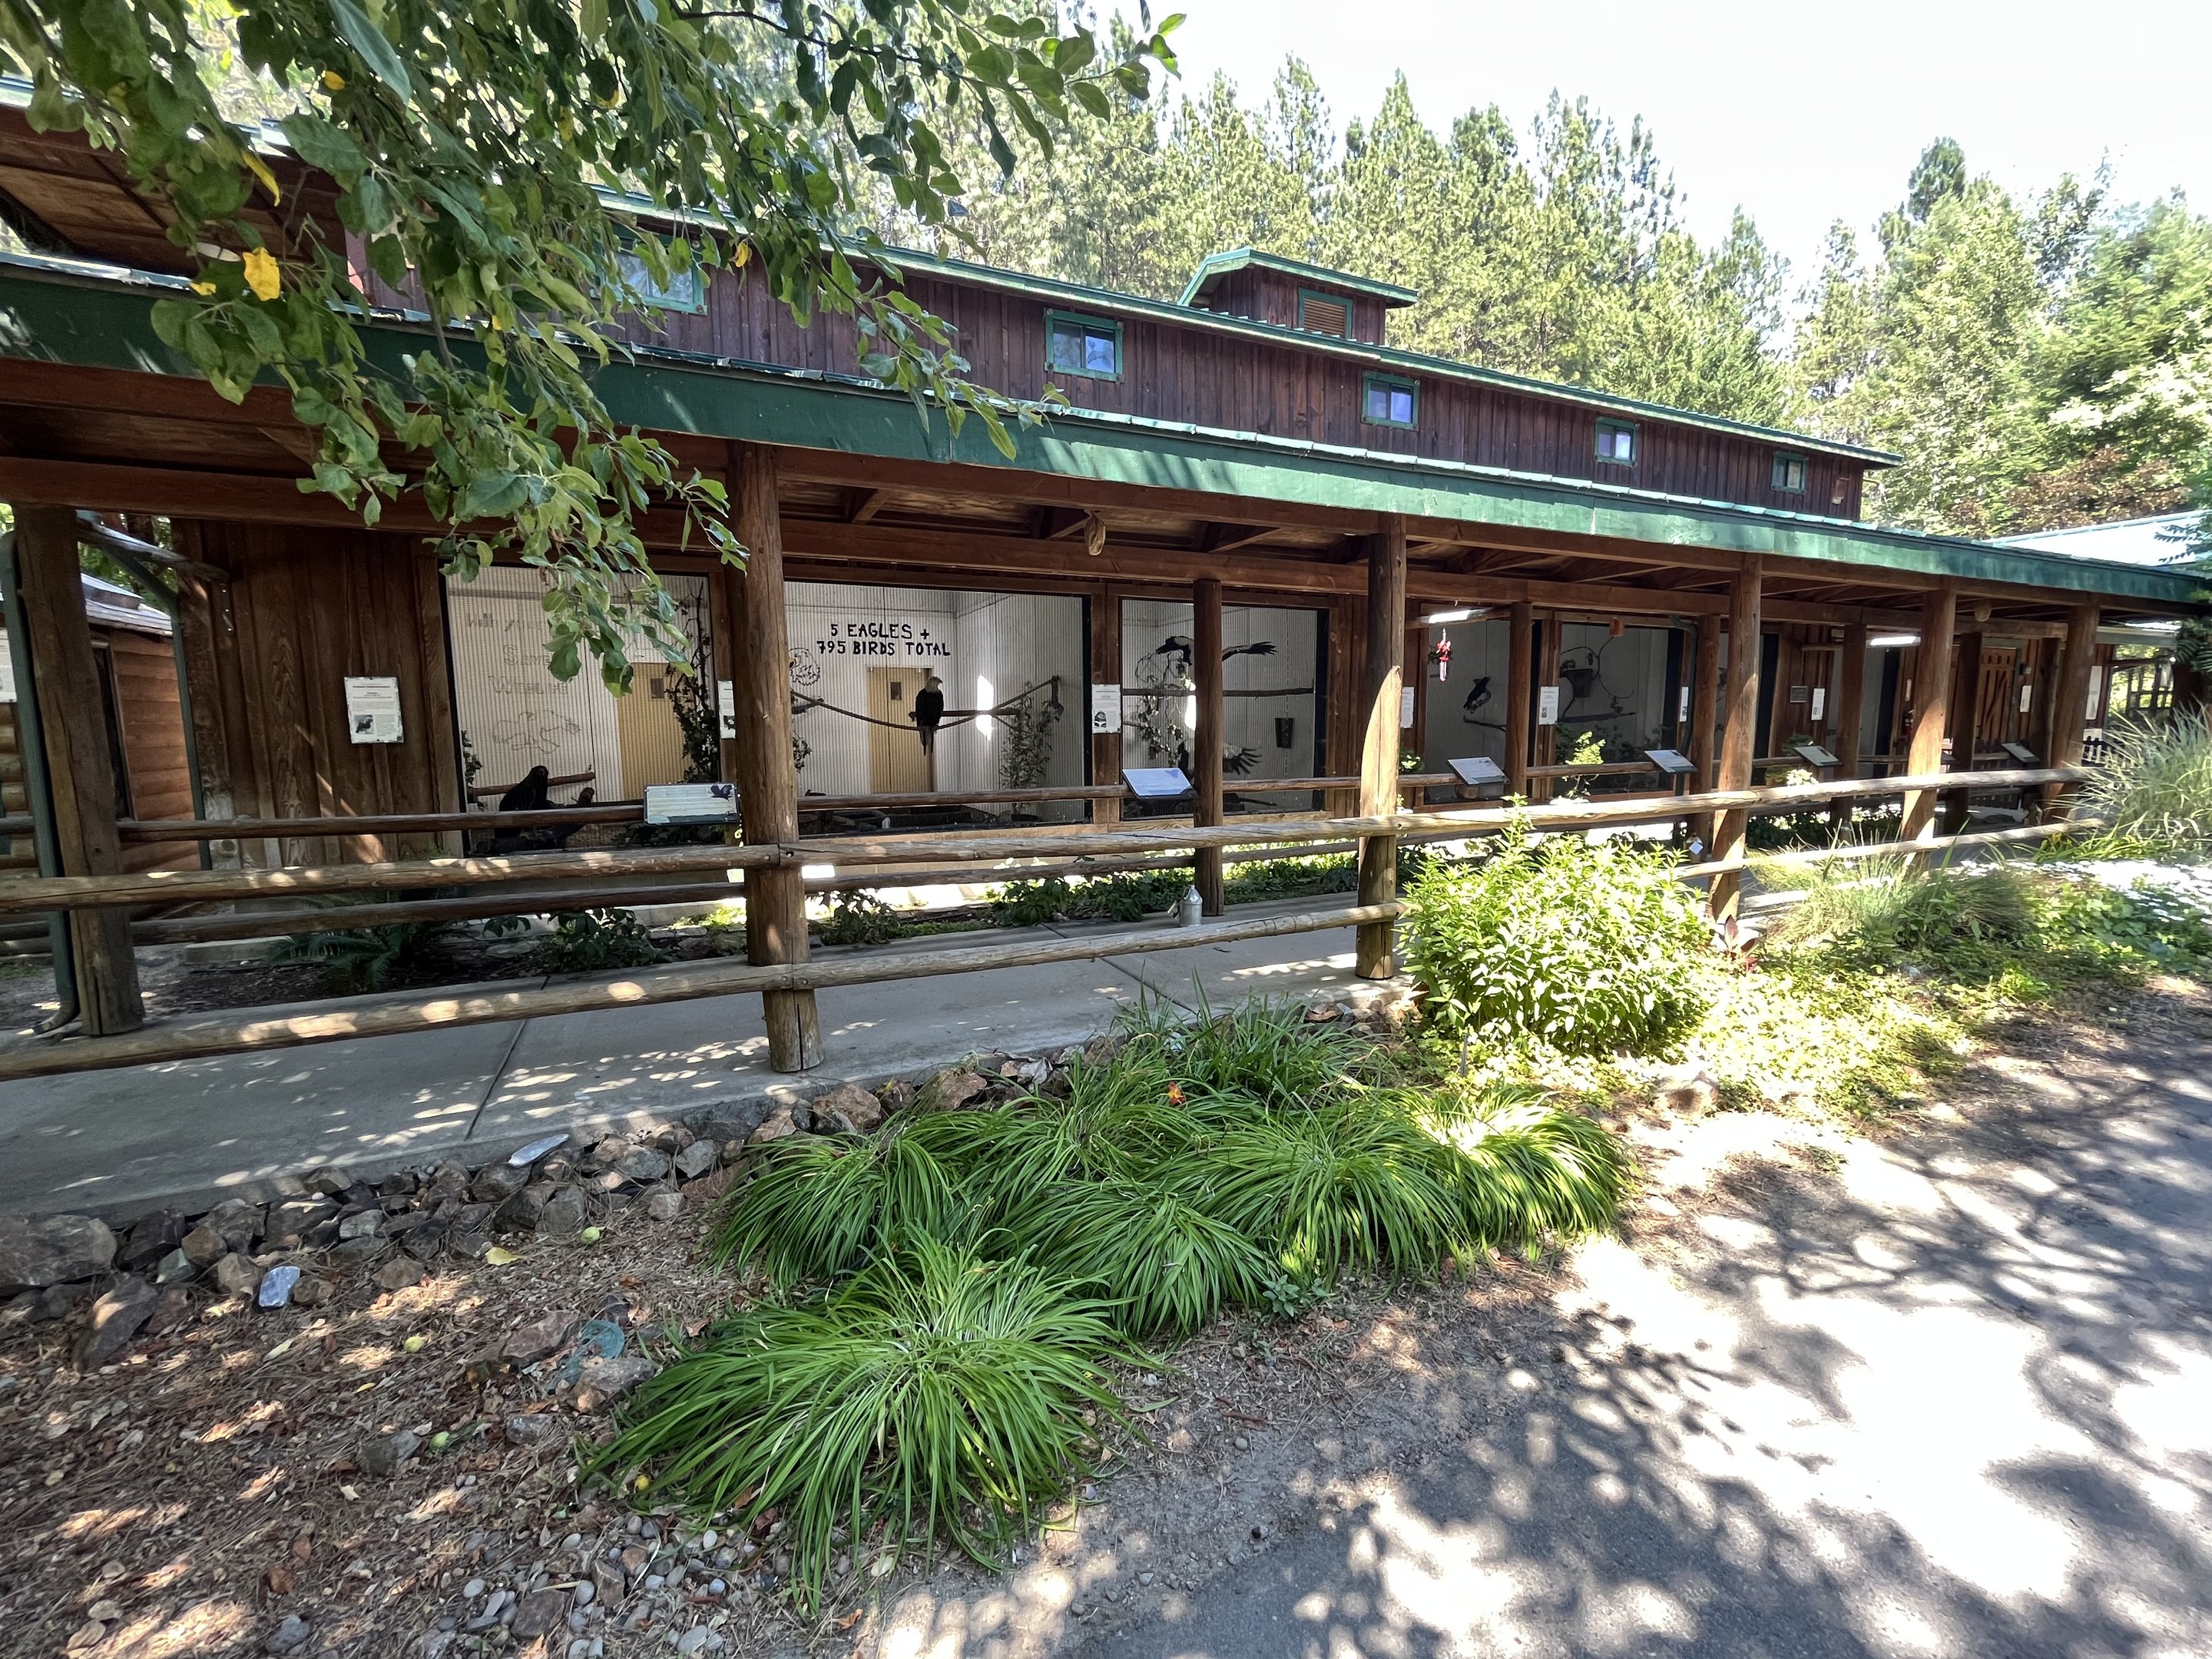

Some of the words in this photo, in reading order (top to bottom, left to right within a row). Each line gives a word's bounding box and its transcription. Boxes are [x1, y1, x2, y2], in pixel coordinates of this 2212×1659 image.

[830, 623, 838, 637] 5
[847, 623, 912, 639] EAGLES
[920, 629, 929, 639] +
[816, 641, 846, 654] 795
[853, 641, 896, 656] BIRDS
[906, 641, 951, 656] TOTAL
